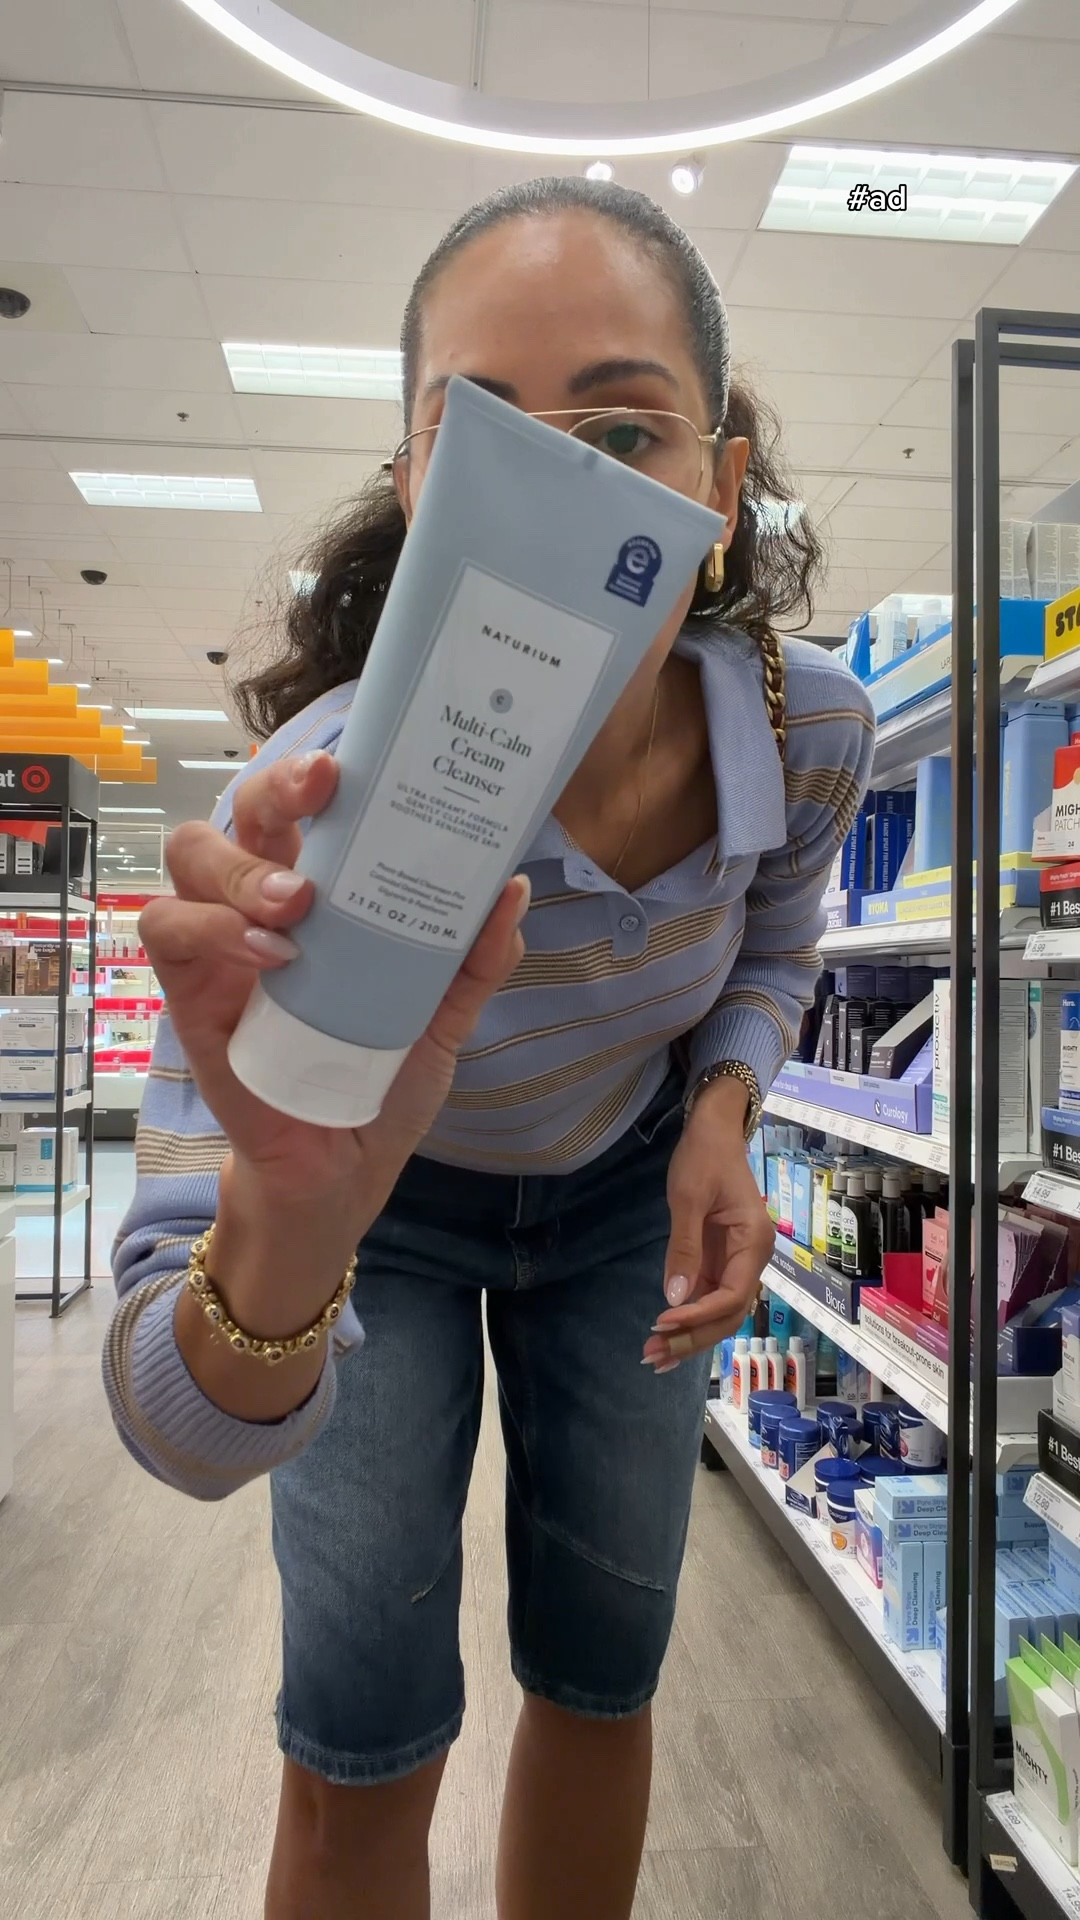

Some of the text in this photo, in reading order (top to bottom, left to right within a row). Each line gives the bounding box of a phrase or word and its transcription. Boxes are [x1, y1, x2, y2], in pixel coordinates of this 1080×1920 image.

[481, 625, 561, 668] NATURIUM
[440, 704, 532, 758] Multi-Calm
[450, 737, 505, 773] Cream
[432, 755, 505, 797] Cleanser
[367, 900, 382, 915] FL
[388, 909, 407, 923] OZ
[419, 921, 440, 935] 210
[441, 927, 457, 940] ML
[1050, 902, 1060, 916] #1
[882, 1104, 908, 1124] Curology
[1053, 1143, 1063, 1159] #1
[826, 1286, 846, 1316] Bioré
[864, 1314, 884, 1336] solutions
[932, 1362, 944, 1380] skin
[1048, 1436, 1059, 1455] #1
[1032, 1492, 1050, 1511] 12.89
[1016, 1740, 1048, 1784] MIGHTY
